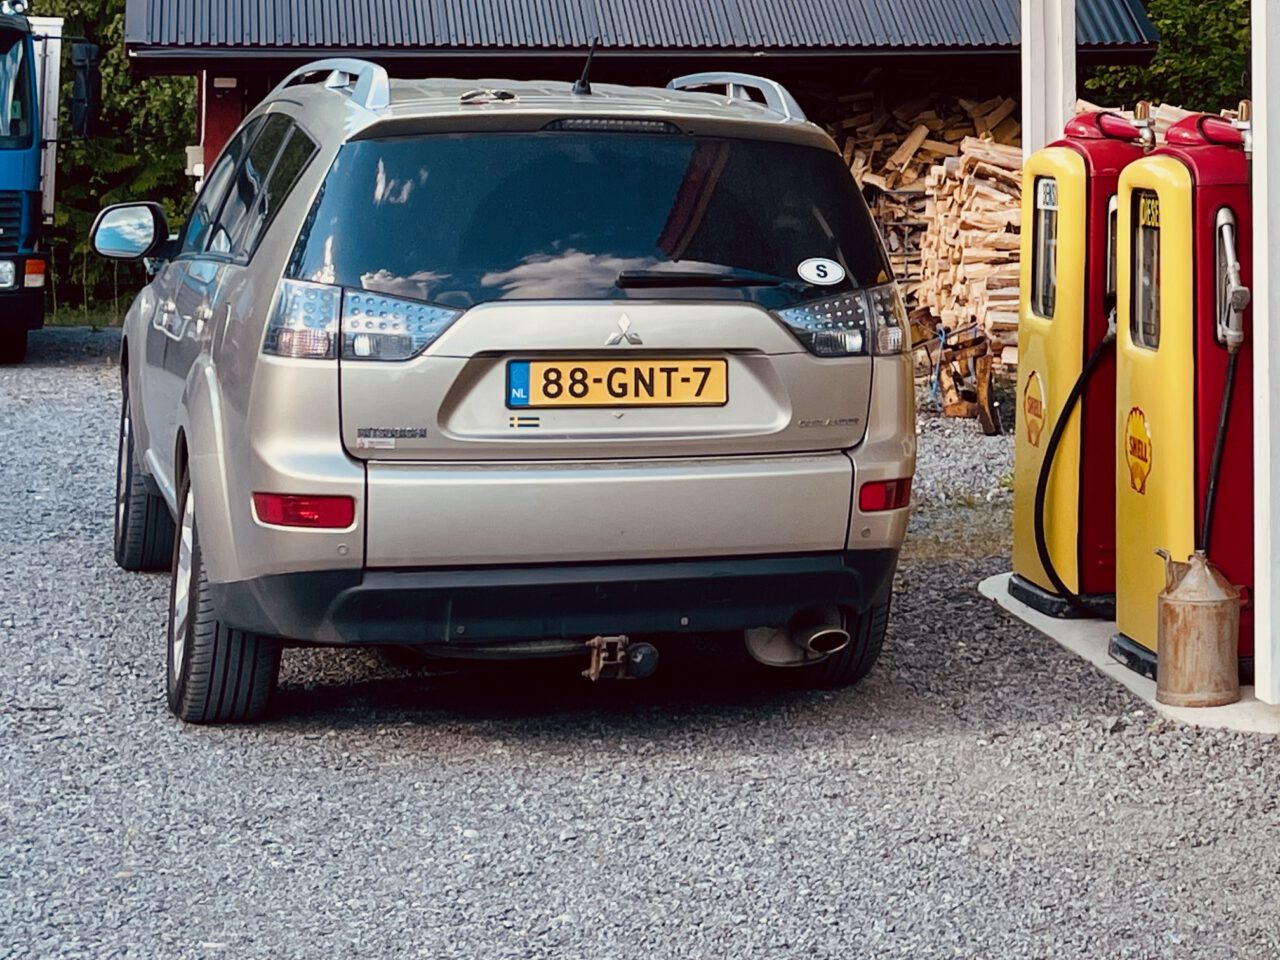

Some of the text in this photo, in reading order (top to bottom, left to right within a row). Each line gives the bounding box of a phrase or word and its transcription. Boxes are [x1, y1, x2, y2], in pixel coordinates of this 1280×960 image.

[816, 264, 828, 278] S
[511, 387, 527, 399] NL
[542, 366, 712, 399] 88-GNT-7
[1129, 435, 1148, 464] SHELL
